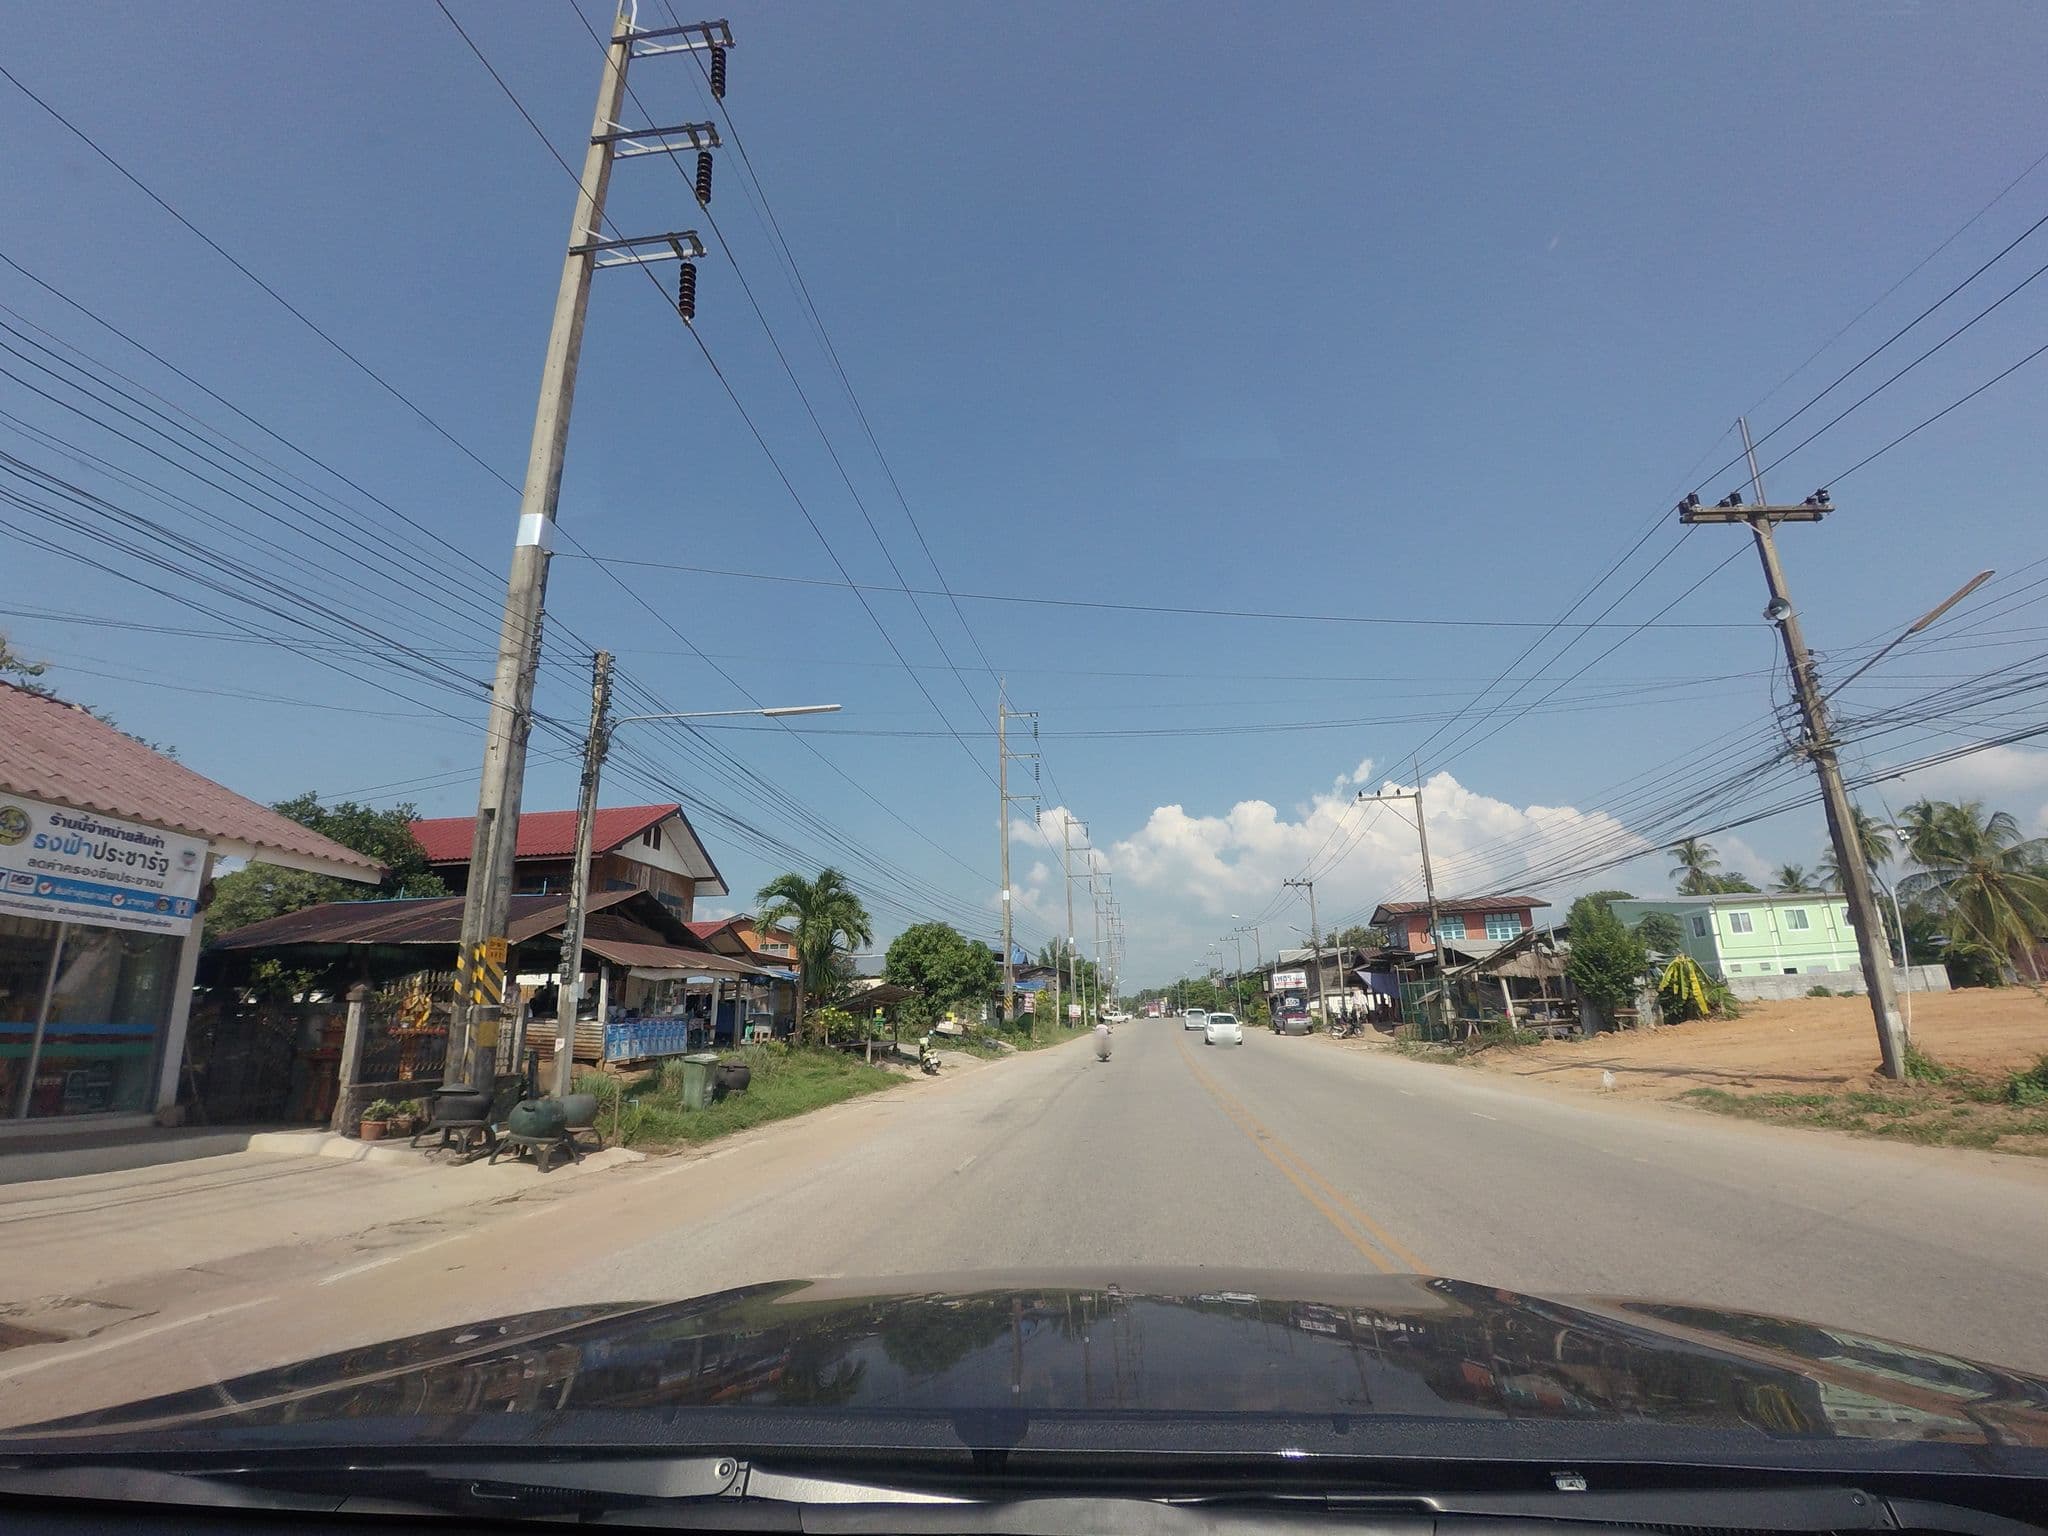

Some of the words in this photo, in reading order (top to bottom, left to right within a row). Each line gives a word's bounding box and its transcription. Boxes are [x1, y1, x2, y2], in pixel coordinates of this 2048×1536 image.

[27, 858, 165, 889] ลดค่าครองชีพประชาชน
[33, 832, 169, 877] ธงฟ้าประชารัฐ
